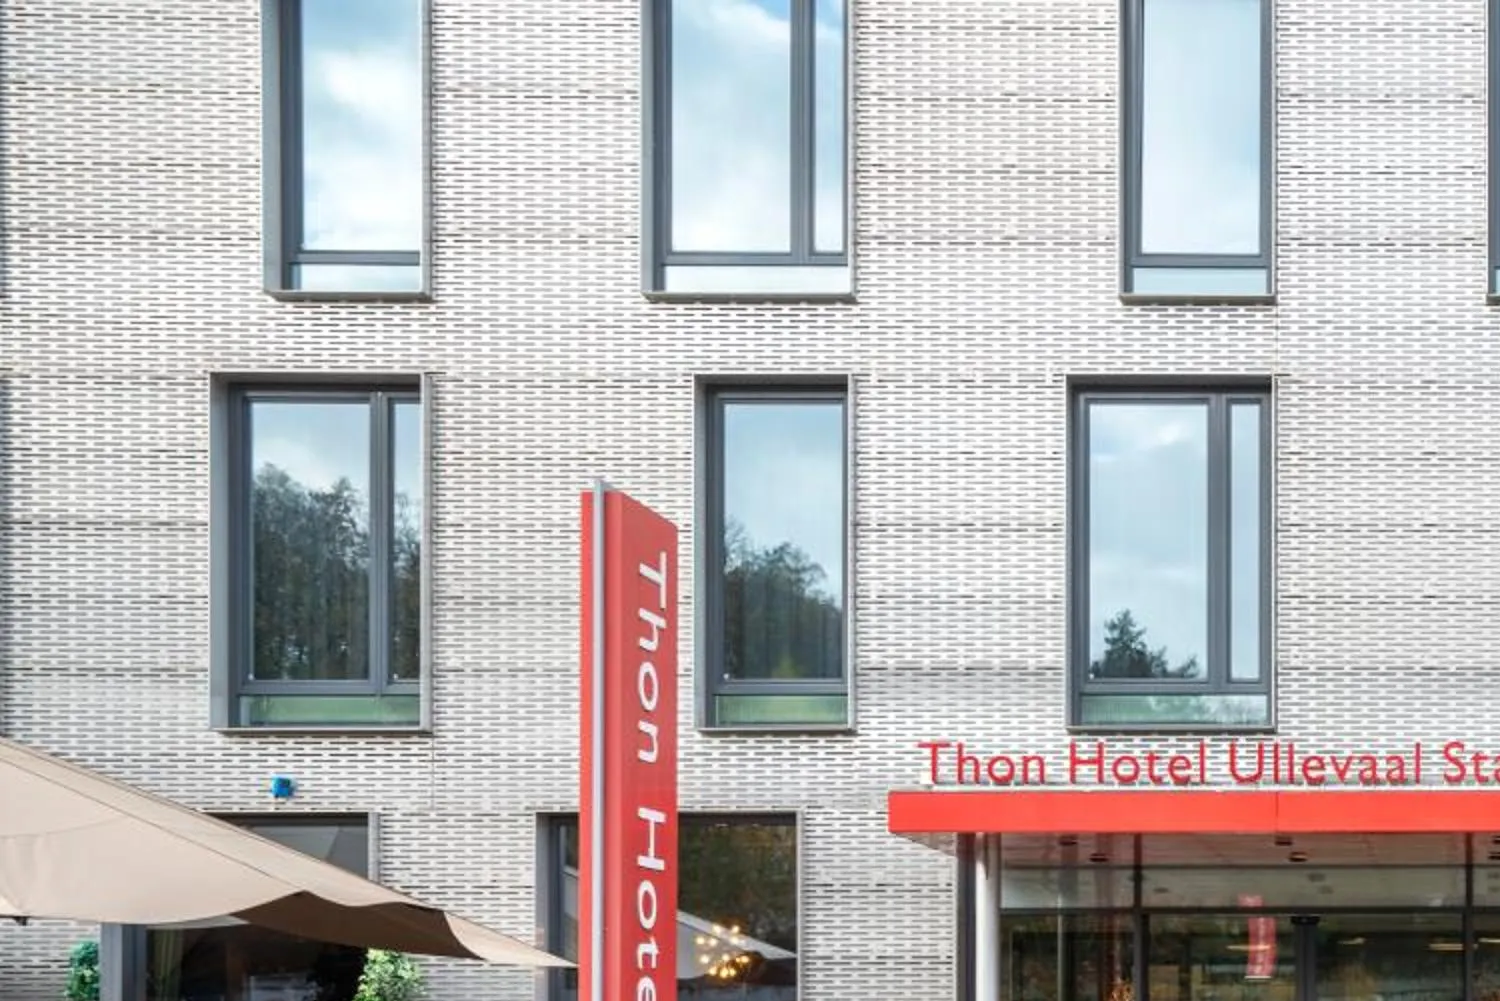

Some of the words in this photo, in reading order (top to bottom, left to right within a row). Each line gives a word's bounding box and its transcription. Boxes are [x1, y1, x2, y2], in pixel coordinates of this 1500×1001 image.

[637, 551, 667, 763] Thon
[917, 741, 1046, 785] Thon
[1069, 741, 1206, 785] Hotel
[1229, 741, 1421, 785] Ullevaal
